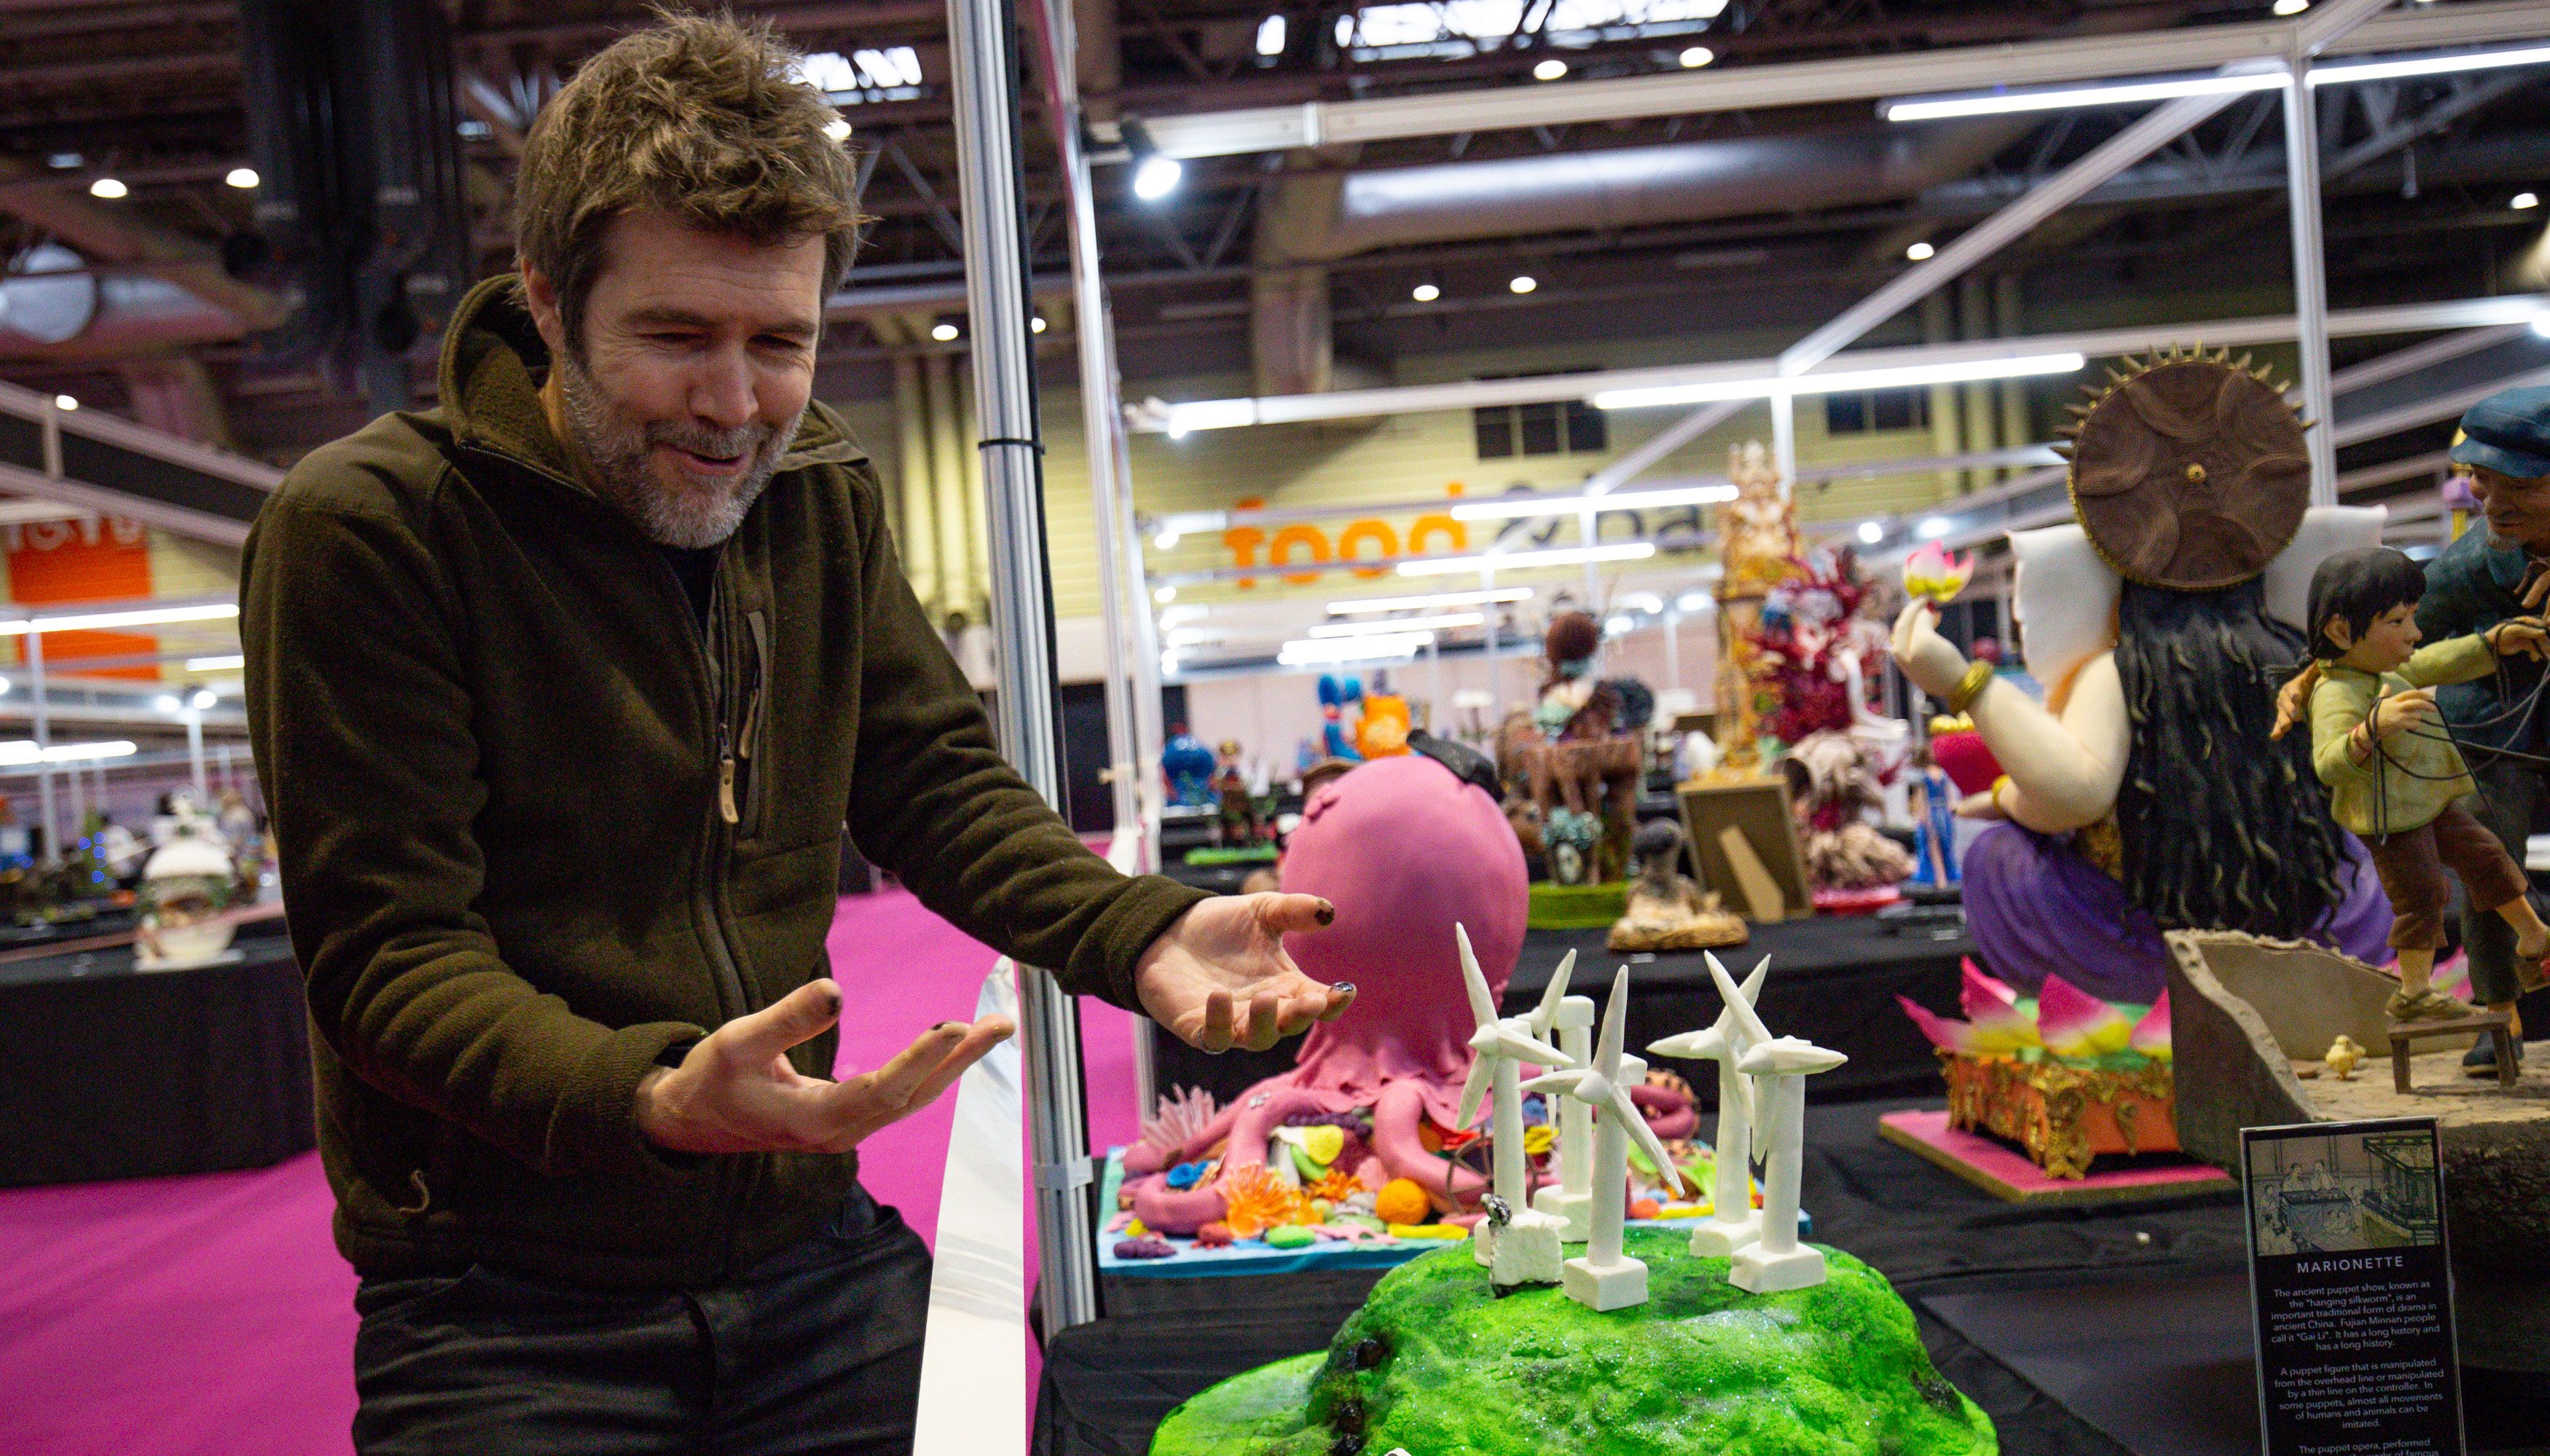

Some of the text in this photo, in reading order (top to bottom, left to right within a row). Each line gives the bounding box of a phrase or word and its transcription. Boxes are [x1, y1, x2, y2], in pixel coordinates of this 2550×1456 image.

[2297, 1256, 2404, 1273] MARIONETTE
[2275, 1288, 2290, 1297] The
[2293, 1288, 2325, 1296] ancient
[2327, 1286, 2359, 1295] puppet
[2389, 1281, 2418, 1289] known
[2396, 1293, 2403, 1301] is
[2272, 1312, 2314, 1321] important
[2317, 1307, 2361, 1317] traditional
[2363, 1306, 2384, 1315] form
[2387, 1305, 2396, 1313] of
[2398, 1303, 2425, 1311] drama
[2274, 1322, 2306, 1331] ancient
[2341, 1318, 2366, 1329] Fujian
[2369, 1315, 2401, 1324] Minnan
[2404, 1313, 2436, 1323] people
[2272, 1334, 2286, 1342] call
[2288, 1334, 2294, 1342] it
[2335, 1331, 2342, 1339] It
[2344, 1329, 2359, 1337] has
[2369, 1327, 2389, 1337] long
[2391, 1326, 2420, 1336] history
[2423, 1324, 2439, 1333] and
[2315, 1342, 2331, 1350] has
[2341, 1341, 2361, 1350] long
[2290, 1366, 2322, 1377] puppet
[2324, 1364, 2350, 1375] figure
[2353, 1363, 2369, 1372] that
[2381, 1358, 2436, 1369] manipulated
[2275, 1380, 2296, 1388] from
[2298, 1378, 2312, 1386] the
[2315, 1376, 2355, 1385] overhead
[2358, 1374, 2374, 1382] line
[2388, 1369, 2444, 1380] manipulated
[2288, 1390, 2299, 1399] by
[2308, 1388, 2325, 1396] thin
[2327, 1386, 2343, 1394] line
[2359, 1384, 2373, 1393] the
[2425, 1381, 2433, 1389] In
[2280, 1393, 2443, 1410] some puppets, almost all movements
[2296, 1412, 2304, 1420] of
[2307, 1409, 2342, 1419] humans
[2344, 1408, 2361, 1417] and
[2363, 1406, 2396, 1415] animals
[2299, 1444, 2315, 1453] The
[2318, 1443, 2350, 1454] puppet
[2383, 1438, 2431, 1449] performed
